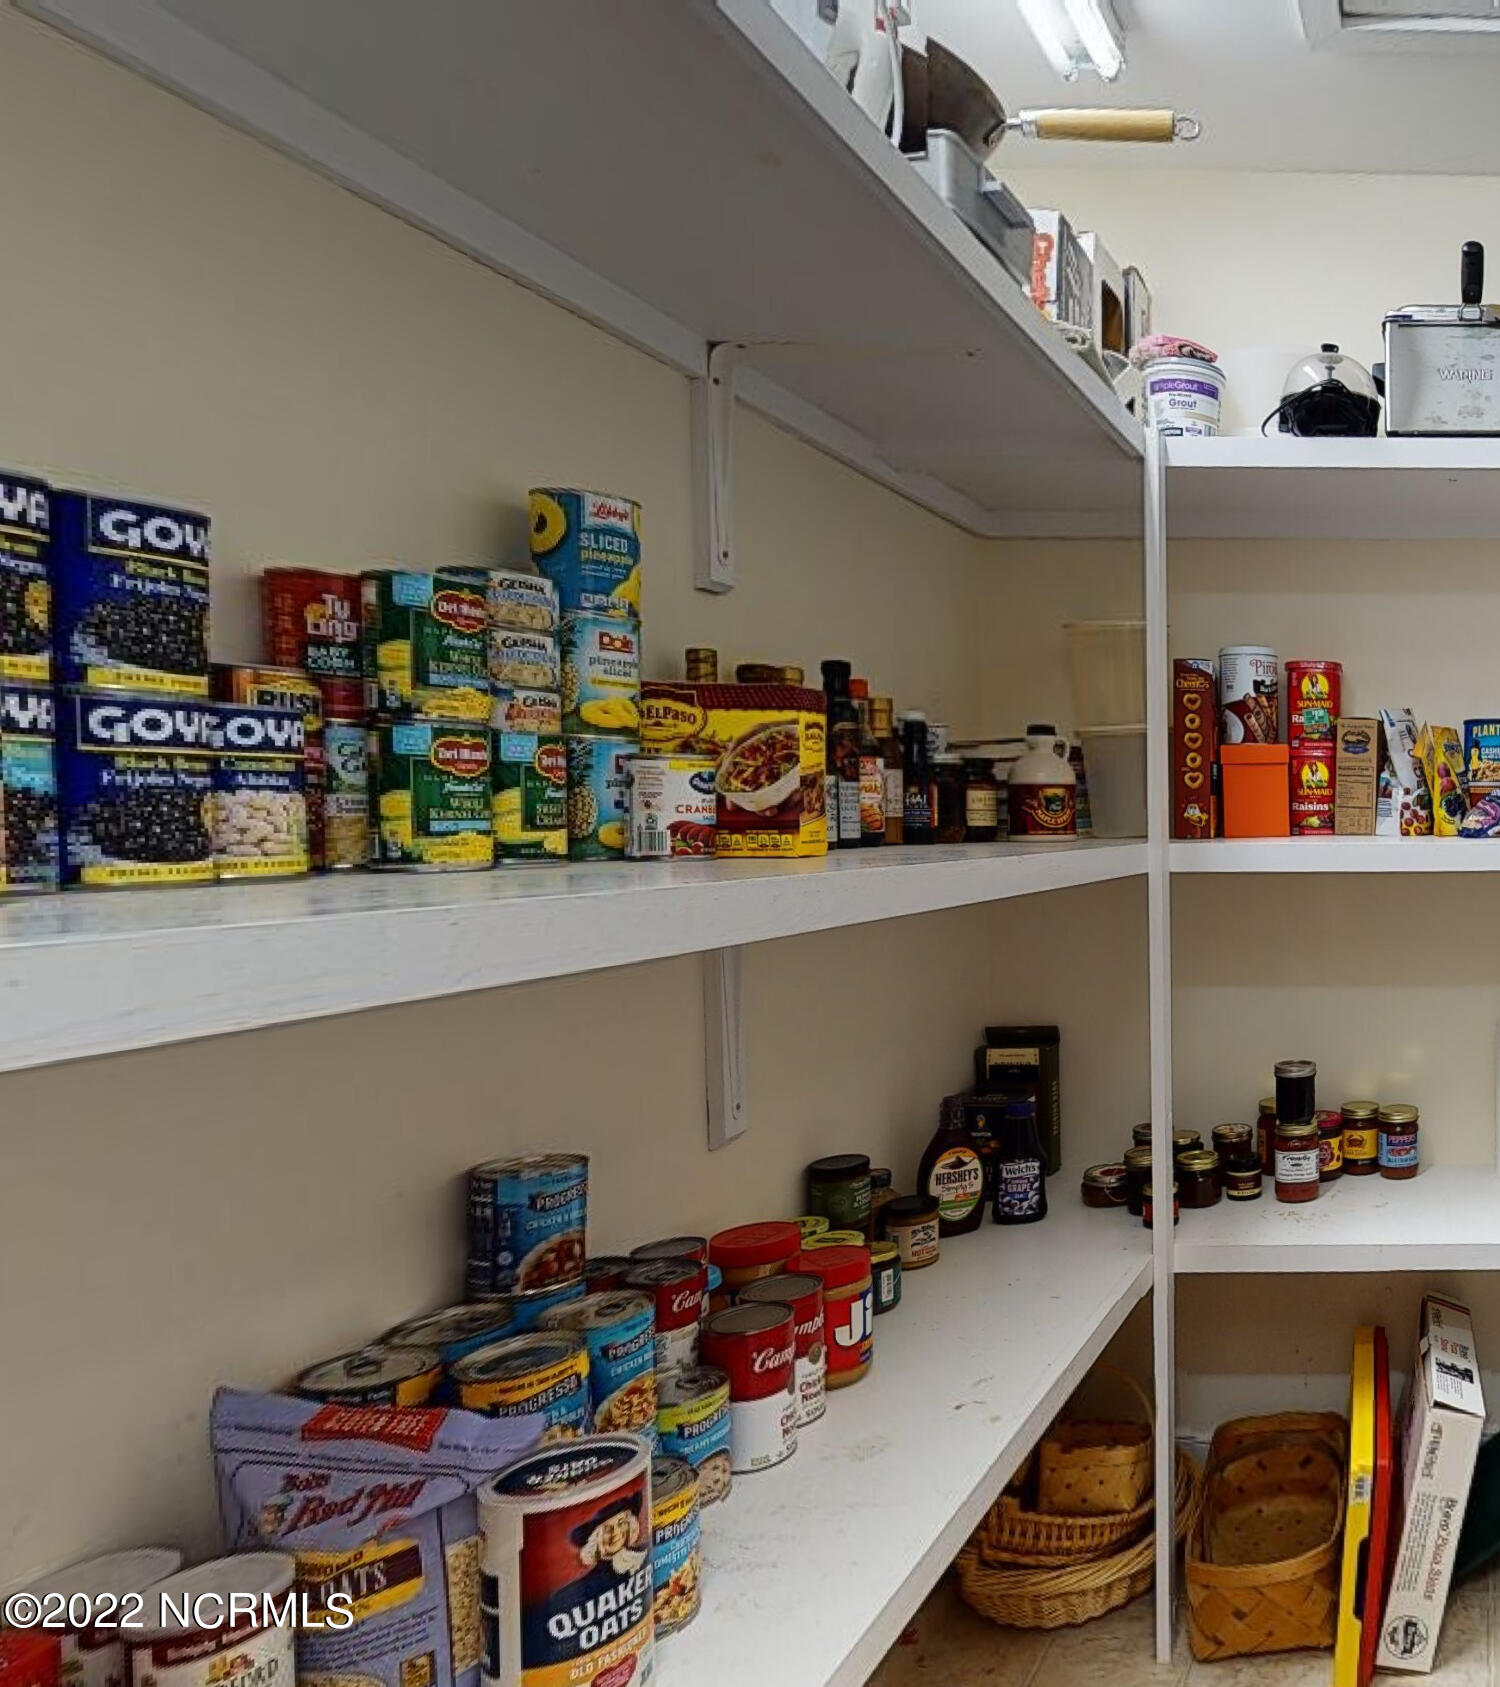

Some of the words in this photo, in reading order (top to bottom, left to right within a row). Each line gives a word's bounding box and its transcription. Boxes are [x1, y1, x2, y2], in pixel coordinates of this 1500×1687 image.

[1438, 367, 1493, 382] WARING
[1169, 398, 1197, 408] Grout
[580, 534, 629, 553] SLICED
[1297, 699, 1334, 709] SUN-MAID
[1297, 787, 1334, 797] SUN-MAID
[1292, 802, 1329, 812] Raisins
[935, 1168, 979, 1186] HERSHEY'S
[1004, 1164, 1036, 1176] Welch's
[1007, 1183, 1031, 1193] GRAPE
[835, 1293, 873, 1347] Ji
[546, 1564, 652, 1639] QUAKER
[579, 1598, 644, 1650] OATS
[570, 1661, 594, 1680] OLD
[597, 1624, 647, 1673] FASHIONED
